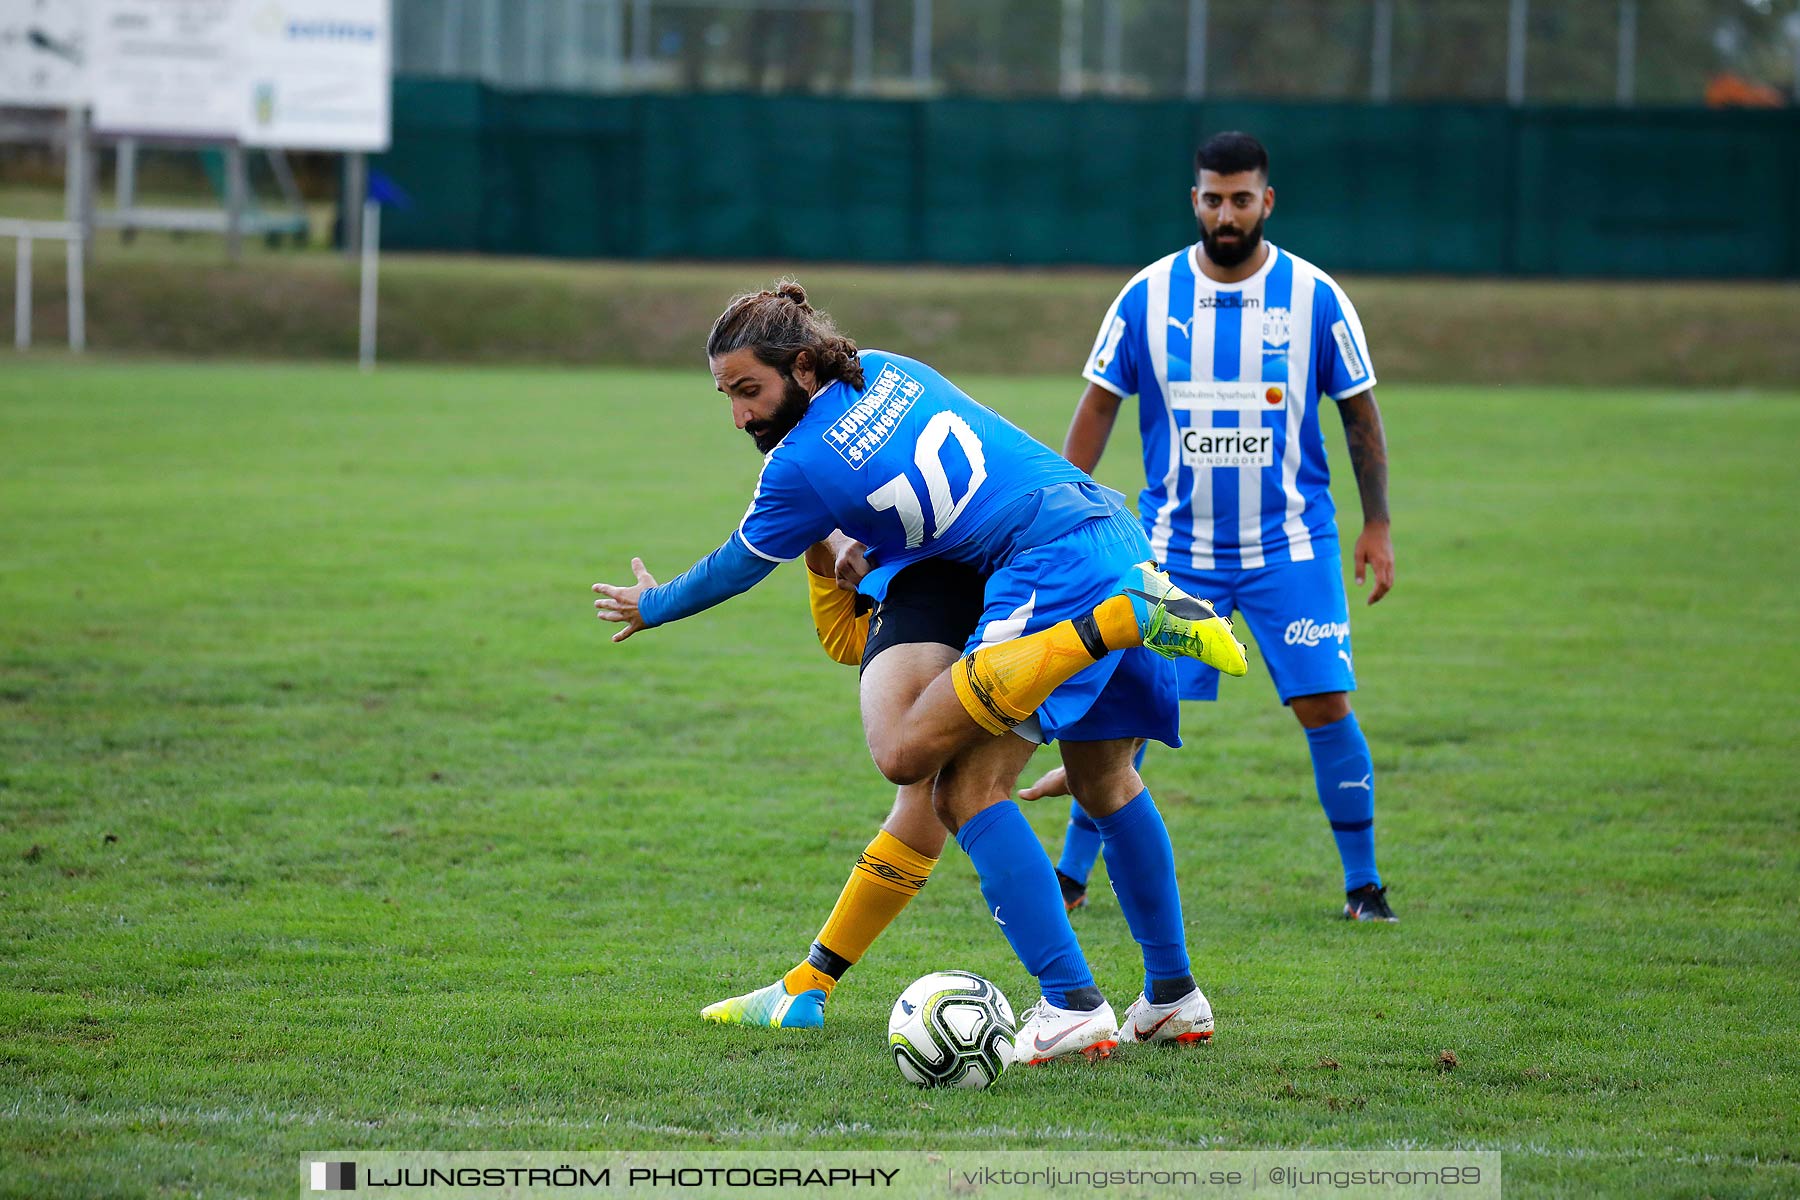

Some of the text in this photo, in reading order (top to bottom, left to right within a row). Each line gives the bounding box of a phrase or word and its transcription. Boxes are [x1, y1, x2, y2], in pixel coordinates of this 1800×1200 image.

[1198, 296, 1259, 309] stadium
[830, 370, 901, 444] LUNDBLADS
[849, 397, 910, 461] STÄNGSEL
[1184, 431, 1270, 454] Carrier
[867, 410, 987, 549] 10
